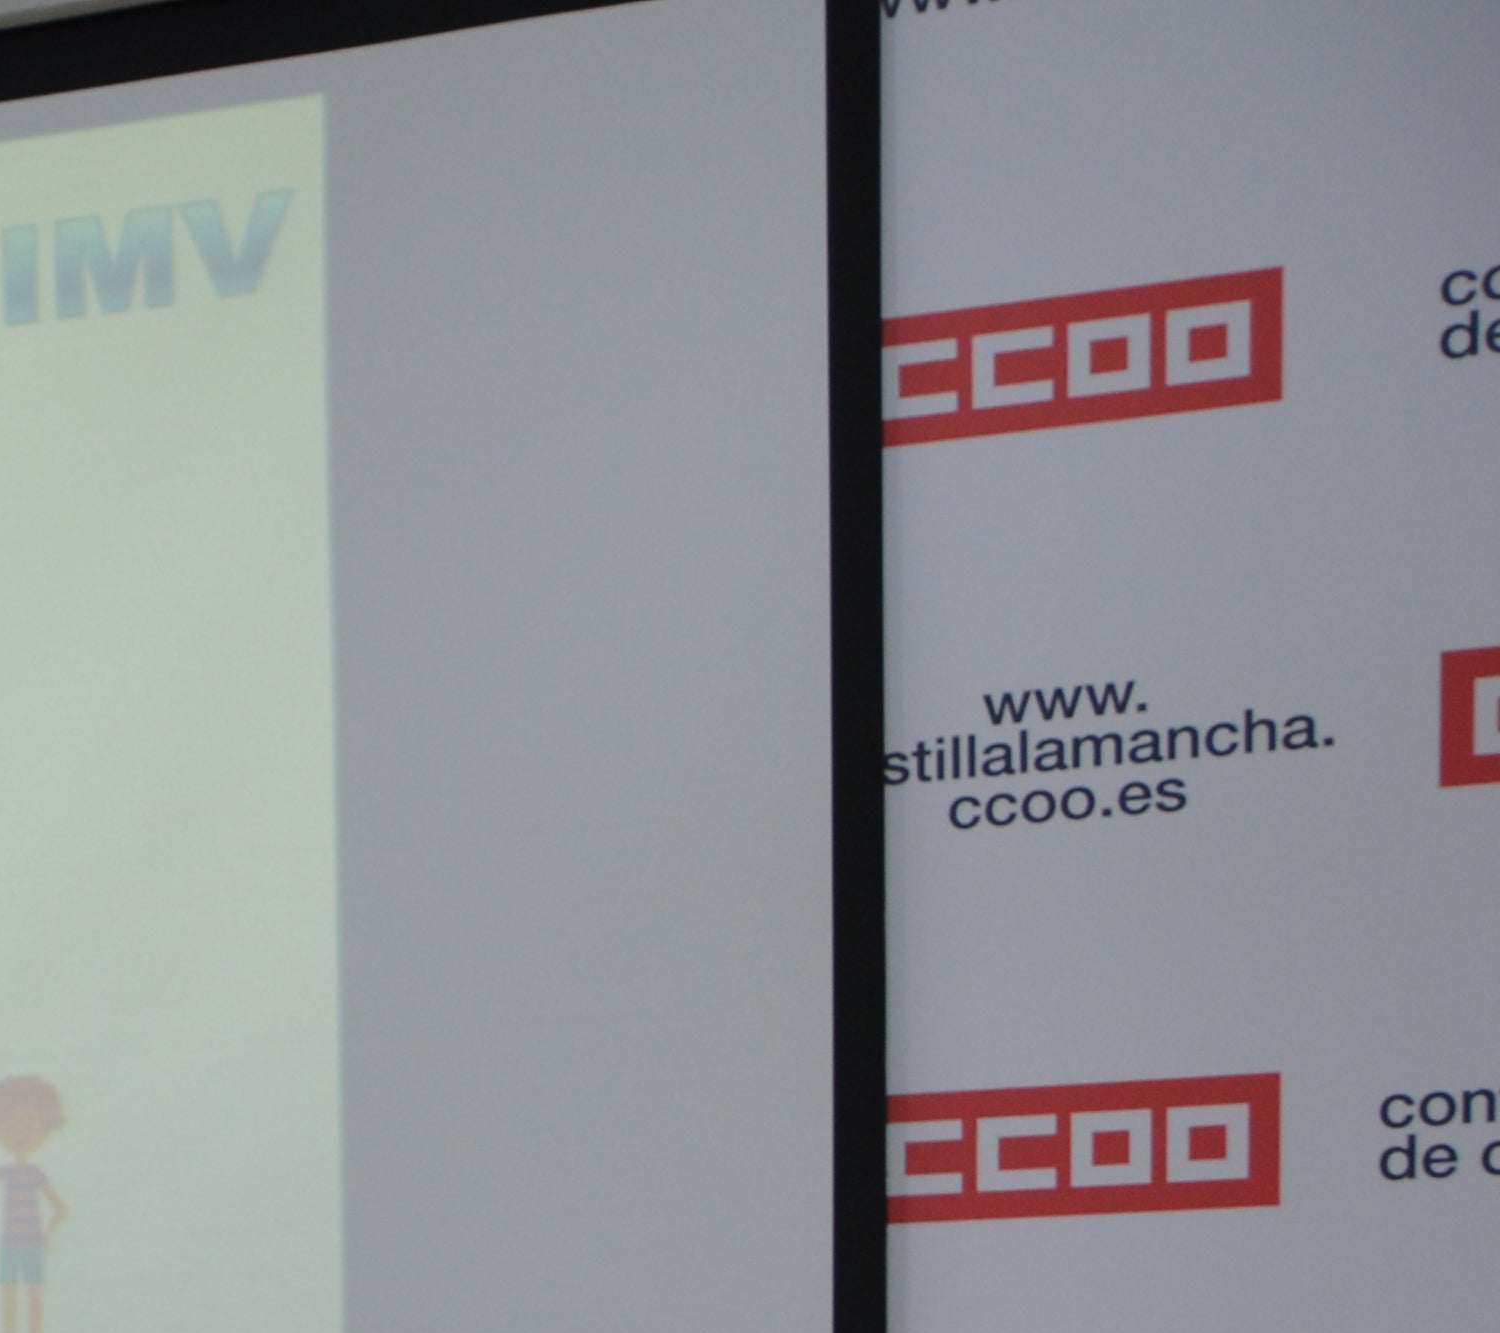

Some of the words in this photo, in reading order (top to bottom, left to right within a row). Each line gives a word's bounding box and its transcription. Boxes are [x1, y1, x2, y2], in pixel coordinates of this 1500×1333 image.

[0, 188, 292, 328] IMV
[882, 298, 1251, 421] CCOO
[982, 680, 1148, 726] www.
[884, 708, 1336, 786] stillalamancha.
[948, 777, 1188, 830] ccoo.es
[887, 1103, 1249, 1195] CCOO
[1379, 1133, 1459, 1182] de
